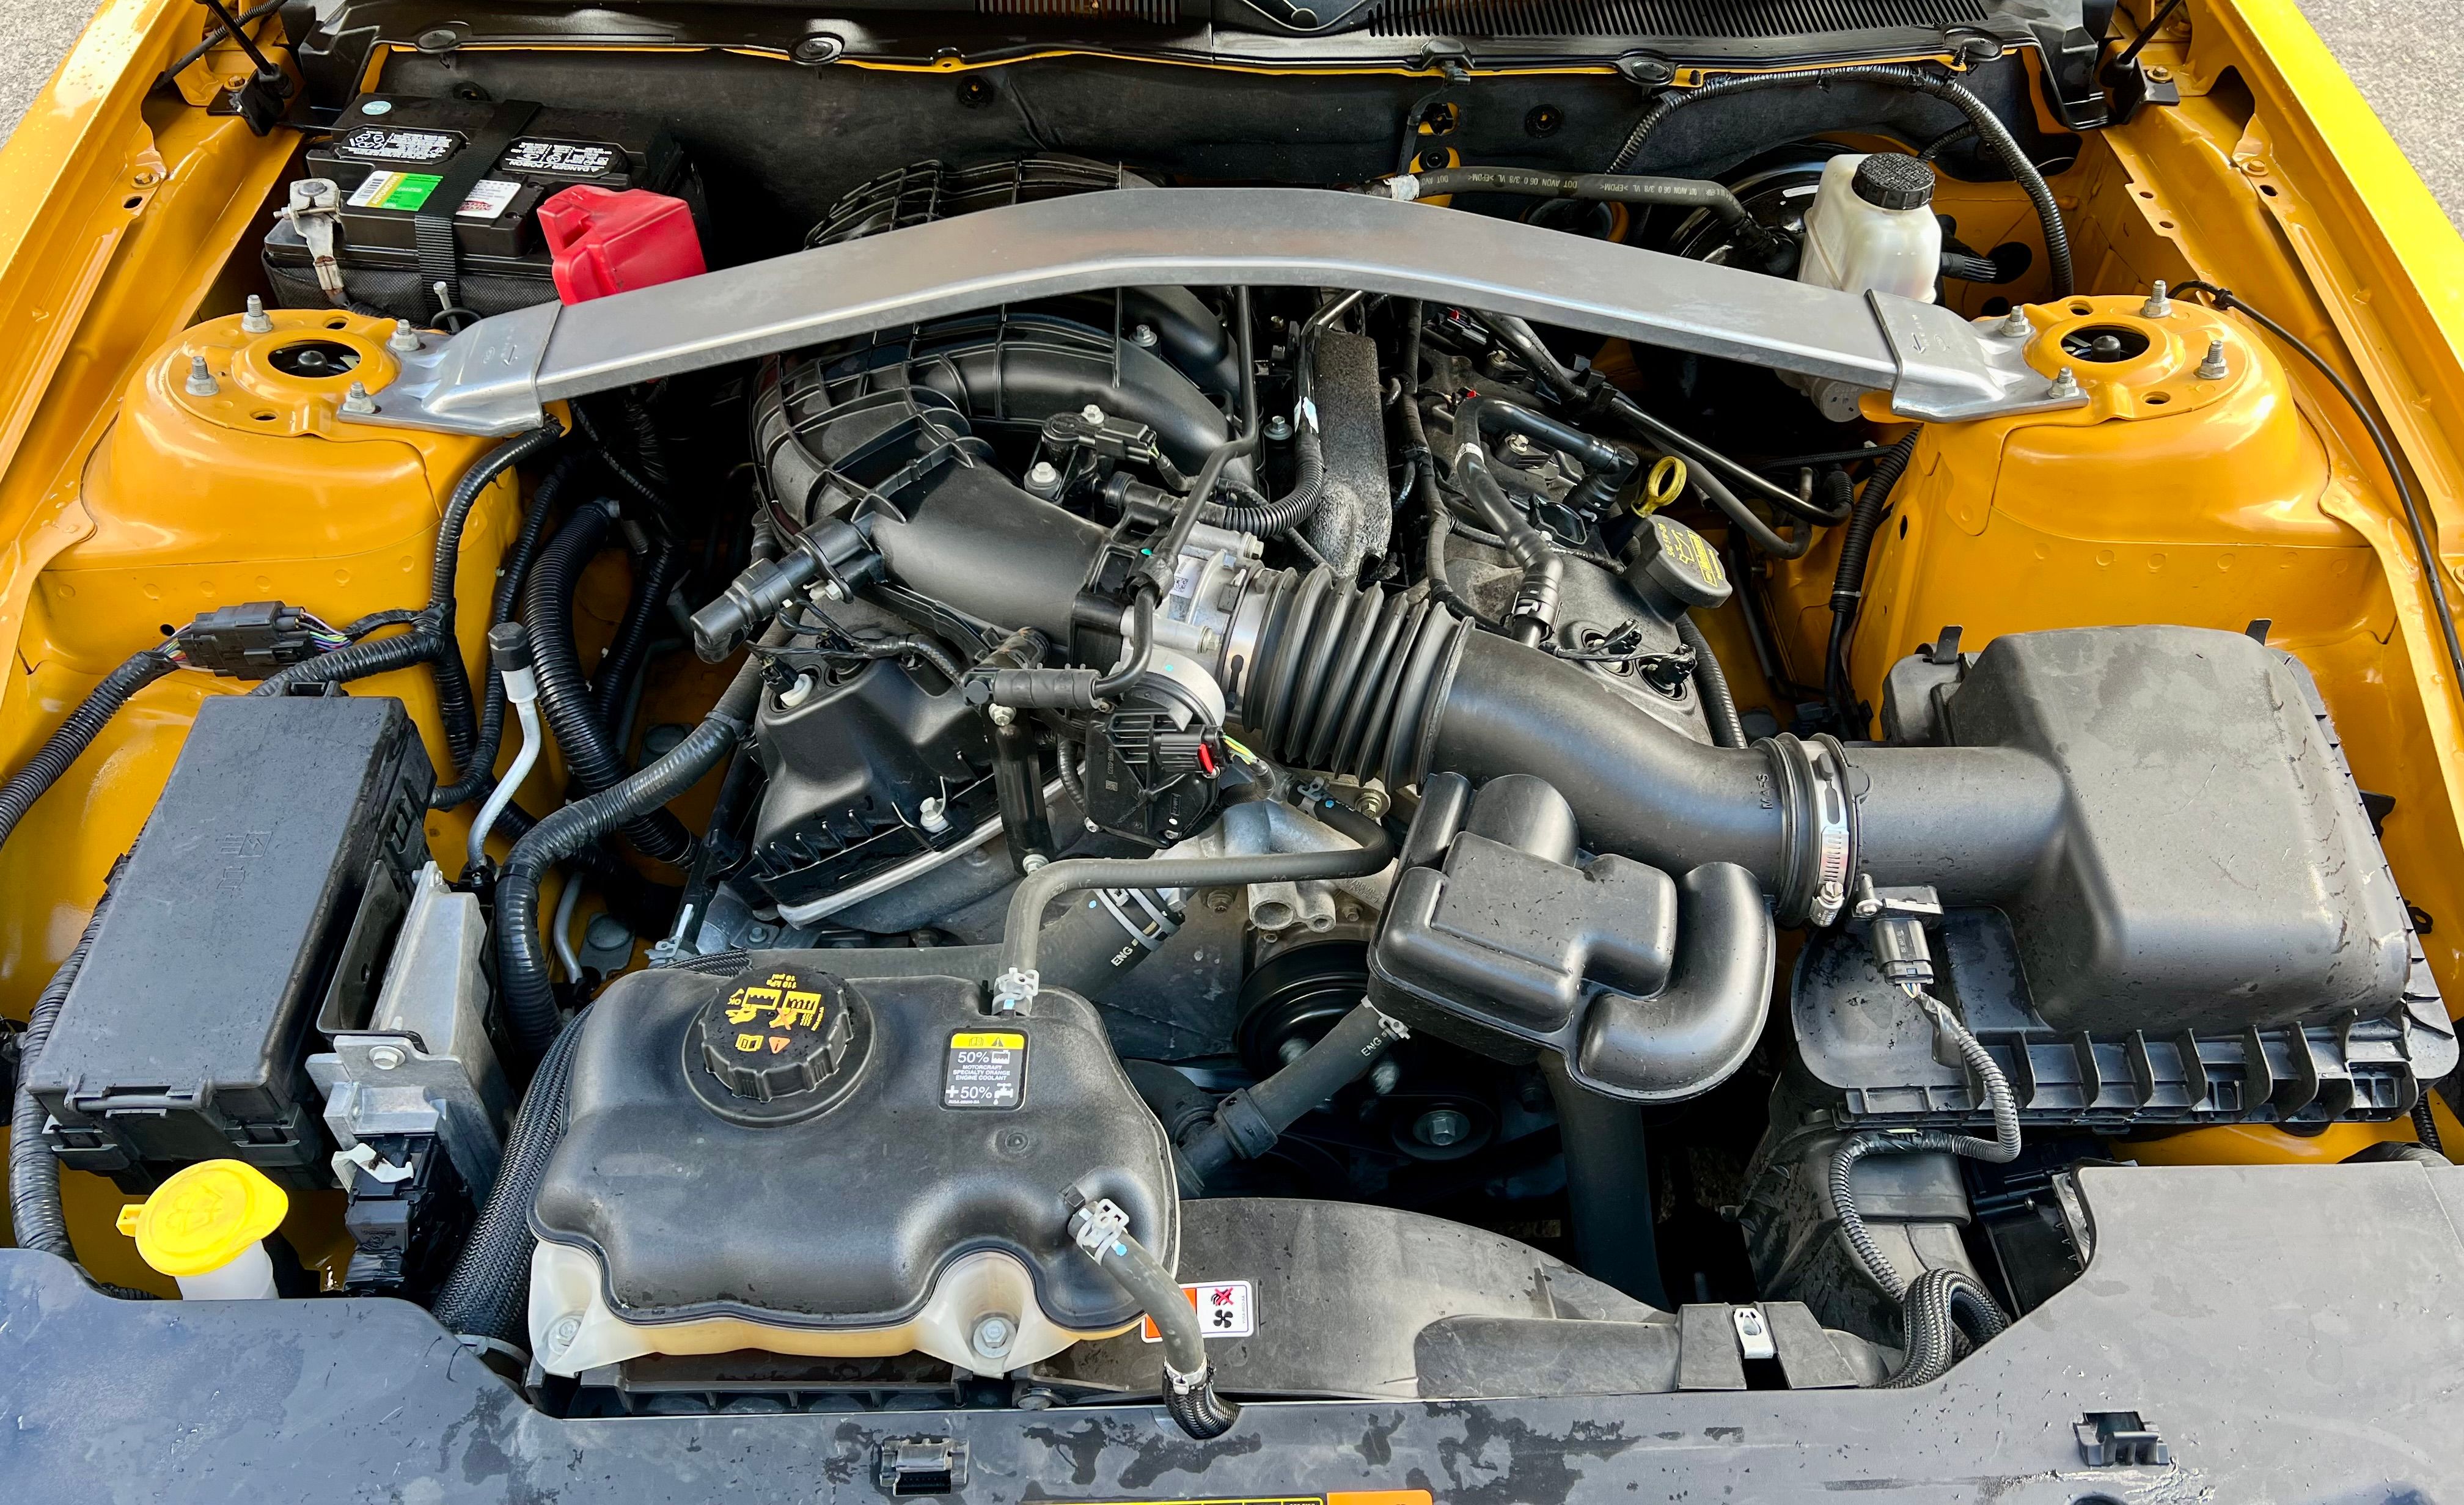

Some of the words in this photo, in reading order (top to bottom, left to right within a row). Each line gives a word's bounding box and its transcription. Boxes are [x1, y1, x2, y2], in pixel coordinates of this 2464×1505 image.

[508, 160, 544, 169] POISON
[551, 164, 590, 172] DANGER
[1420, 177, 1433, 186] AVO
[1437, 175, 1449, 184] DOT
[1467, 173, 1494, 182] >EPDM<
[1498, 174, 1505, 183] VL
[1509, 175, 1520, 184] 3/8
[1542, 178, 1560, 187] AVON
[1564, 180, 1577, 188] DOT
[370, 172, 401, 205] AUTOMOTIVE
[1599, 183, 1629, 192] >EPDM<
[1633, 185, 1640, 193] VL
[1673, 186, 1687, 195] AVON
[1665, 543, 1676, 557] SAE
[1110, 945, 1134, 967] ENG
[766, 979, 782, 988] kPa
[1360, 1036, 1383, 1057] ENG
[958, 1052, 989, 1063] 50%
